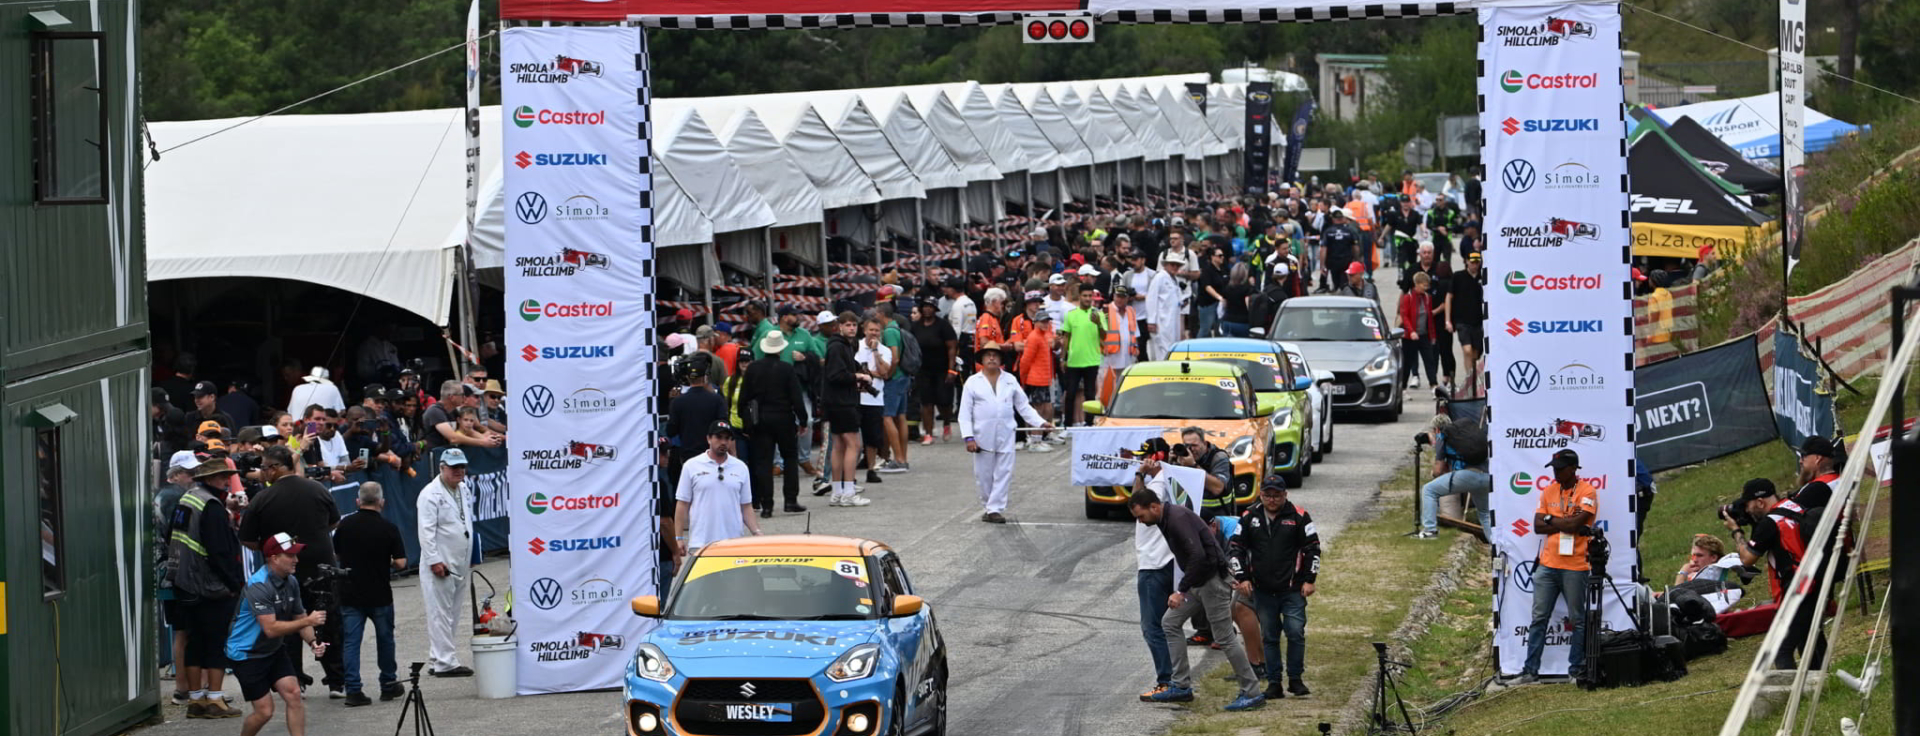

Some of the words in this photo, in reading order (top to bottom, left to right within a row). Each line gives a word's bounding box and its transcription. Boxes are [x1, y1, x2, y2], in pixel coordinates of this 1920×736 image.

[1497, 26, 1538, 36] SIMOLA
[1781, 19, 1804, 54] MG
[1504, 36, 1559, 46] HILLCLIMB
[510, 63, 548, 74] SIMOLA
[516, 72, 568, 83] HILLCLIMB
[1526, 72, 1597, 90] Castrol
[538, 109, 605, 125] Castrol
[1524, 118, 1598, 132] SUZUKI
[535, 153, 607, 166] SUZUKI
[1544, 172, 1600, 185] Simola
[556, 204, 609, 217] Simola
[1500, 227, 1541, 237] SIMOLA
[1508, 236, 1563, 248] HILLCLIMB
[515, 256, 554, 267] SIMOLA
[522, 266, 574, 277] HILLCLIMB
[1530, 274, 1602, 290] Castrol
[544, 301, 612, 318] Castrol
[1527, 320, 1603, 333] SUZUKI
[542, 346, 614, 360] SUZUKI
[1260, 356, 1275, 364] 79
[1219, 380, 1236, 388] 80
[1549, 374, 1604, 386] Simola
[563, 397, 616, 409] Simola
[1645, 397, 1701, 430] NEXT?
[1506, 428, 1546, 438] SIMOLA
[1513, 438, 1568, 449] HILLCLIMB
[522, 450, 561, 460] SIMOLA
[529, 460, 582, 470] HILLCLIMB
[1086, 461, 1129, 470] HILLCLIMB
[551, 493, 619, 511] Castrol
[549, 536, 621, 552] SUZUKI
[840, 564, 860, 575] 81
[571, 588, 622, 601] Simola
[677, 631, 837, 646] SUZUKI
[530, 642, 569, 652] SIMOLA
[537, 650, 590, 662] HILLCLIMB
[726, 705, 775, 720] WESLEY
